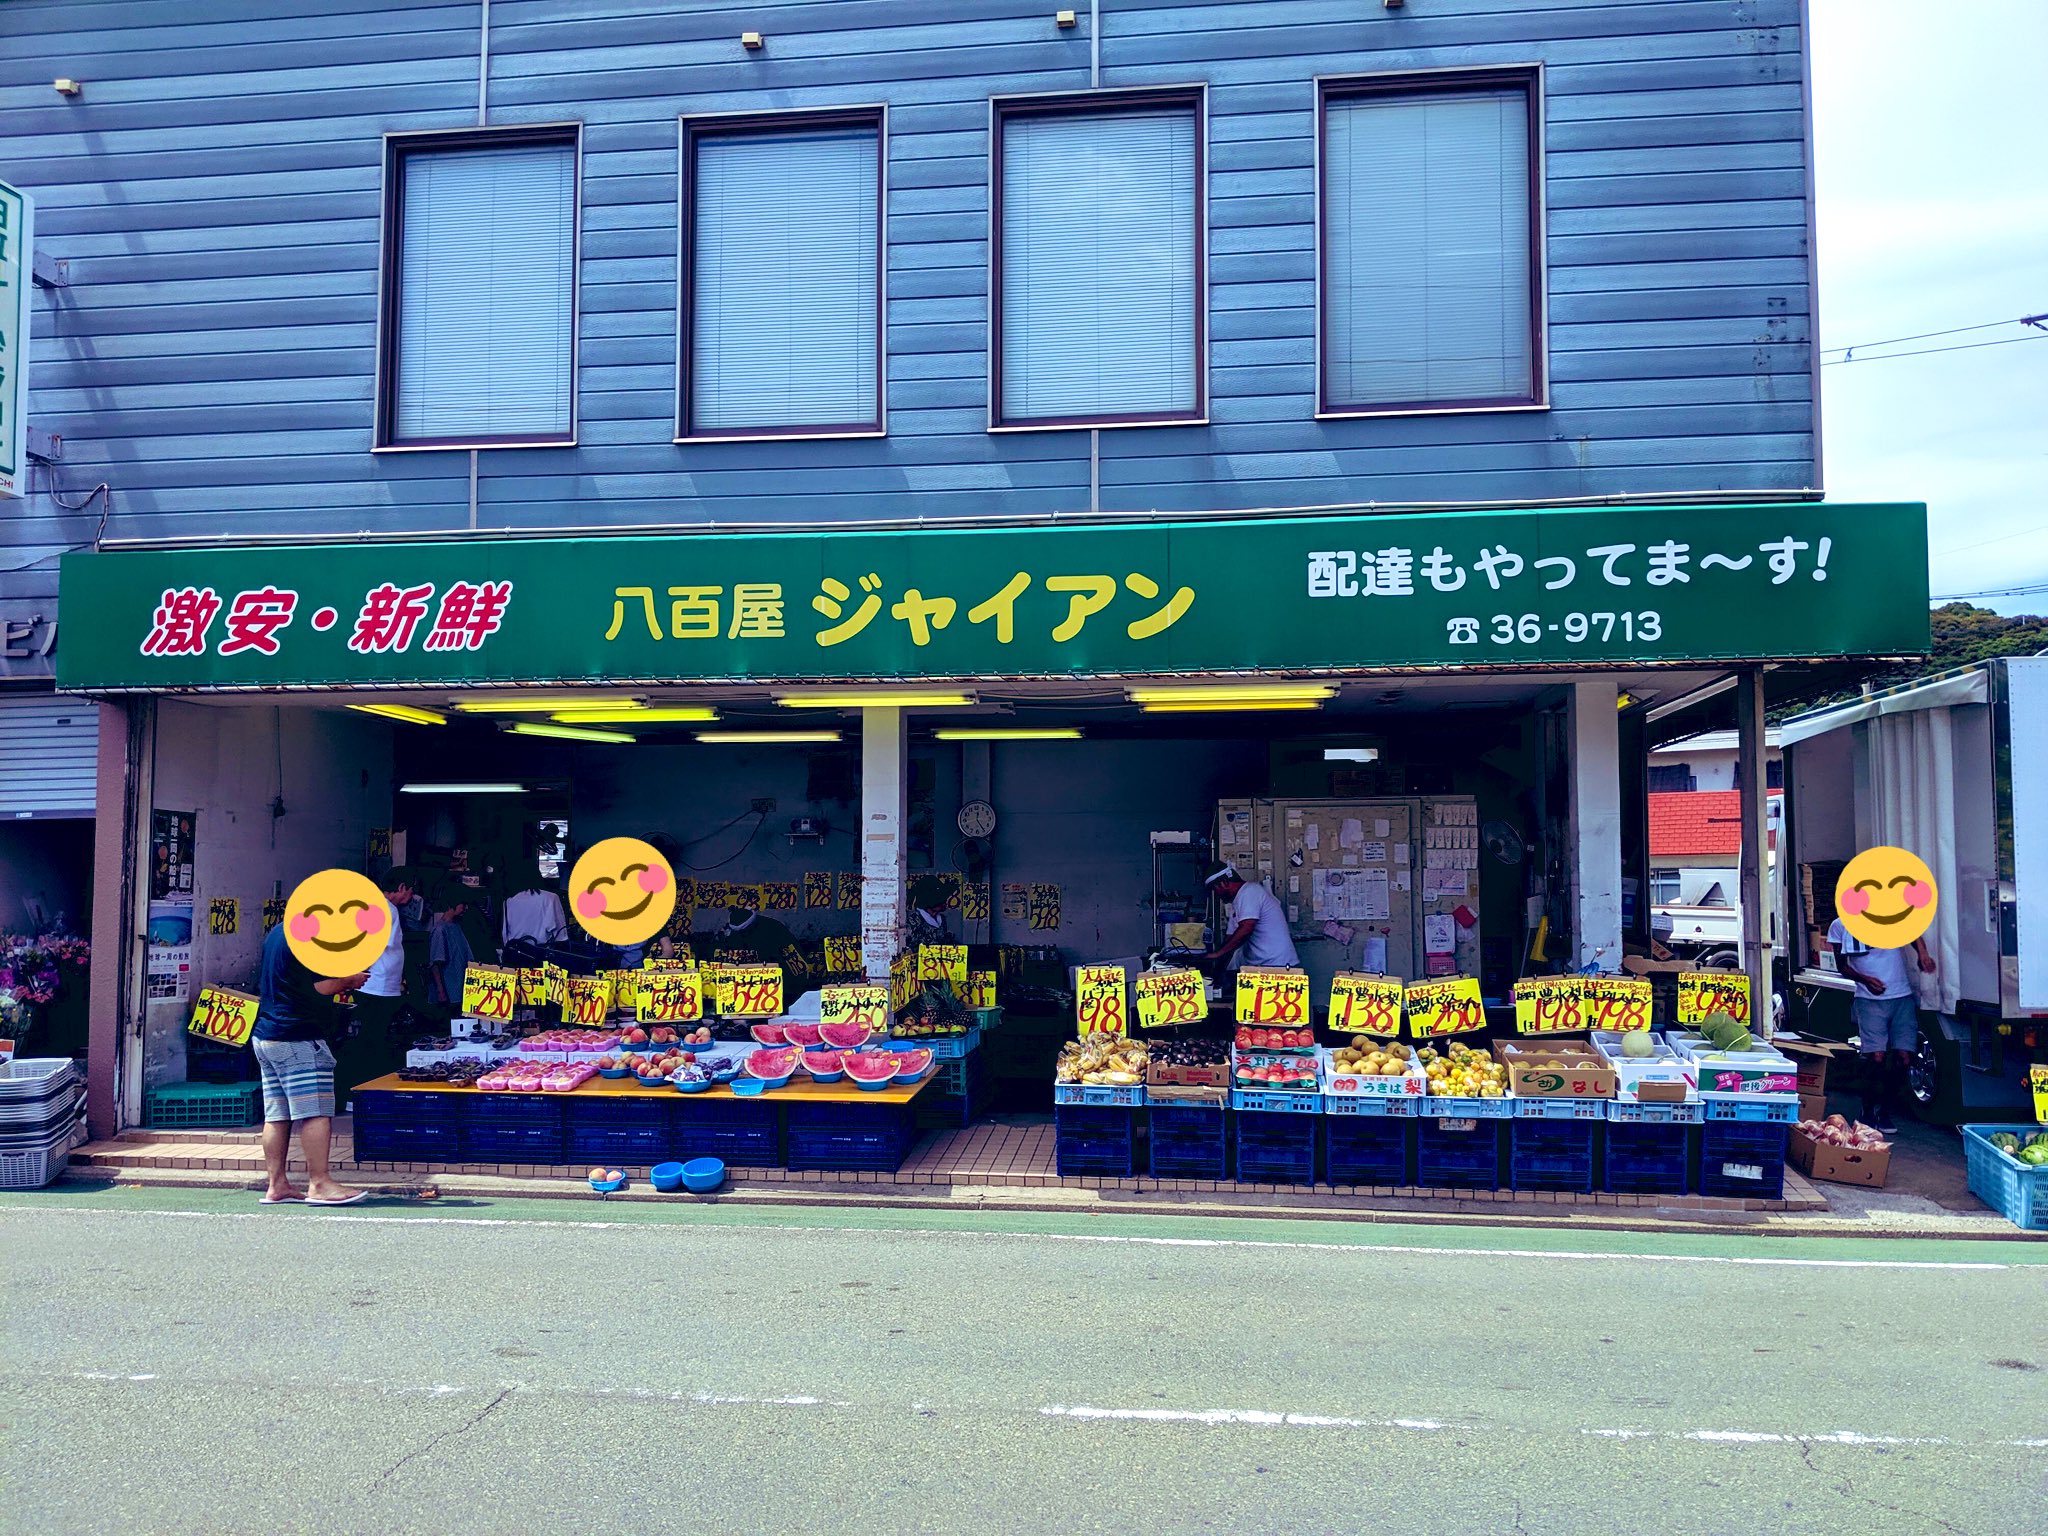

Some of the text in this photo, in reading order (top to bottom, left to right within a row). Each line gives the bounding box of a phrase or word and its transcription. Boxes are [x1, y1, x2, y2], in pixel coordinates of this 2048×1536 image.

[139, 580, 513, 657] 激安・新鮮
[605, 572, 1195, 646] 八百屋 ジャイアン
[1490, 611, 1662, 643] 36-9713
[473, 985, 512, 1018] 250
[573, 991, 606, 1022] 500
[652, 987, 698, 1020] 598
[733, 982, 780, 1012] 598
[1082, 988, 1123, 1001] バナナ
[1254, 986, 1302, 1023] 138
[204, 1006, 247, 1040] 100
[1079, 996, 1123, 1034] 98
[1343, 991, 1394, 1034] 138
[1430, 1001, 1481, 1034] 250
[1535, 998, 1581, 1031] 198
[1594, 997, 1645, 1031] 798
[1572, 1080, 1607, 1094] なし
